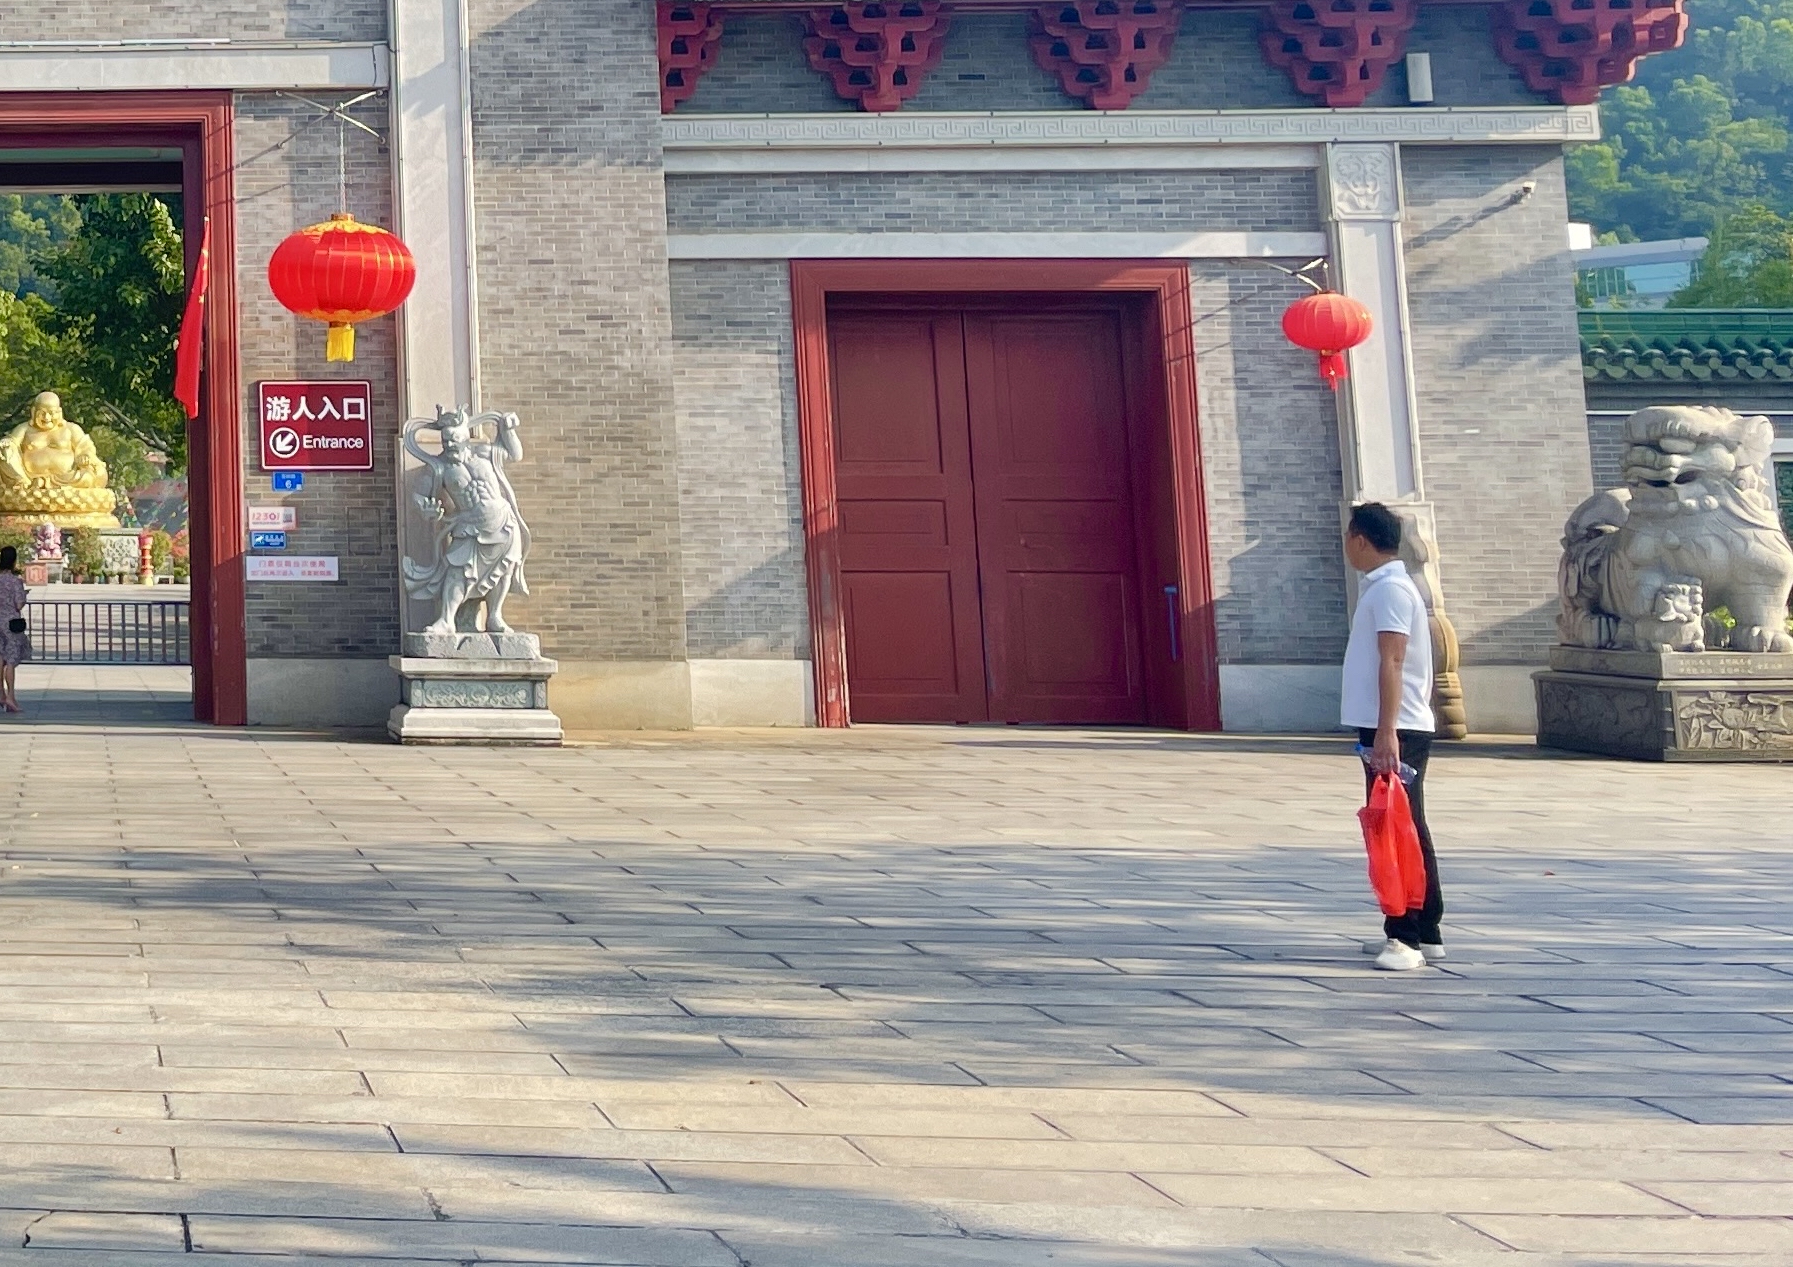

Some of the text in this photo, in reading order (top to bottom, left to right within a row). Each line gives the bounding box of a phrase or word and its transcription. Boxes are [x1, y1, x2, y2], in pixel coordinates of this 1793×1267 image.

[266, 396, 366, 421] 游人入口
[302, 434, 364, 449] Entrance
